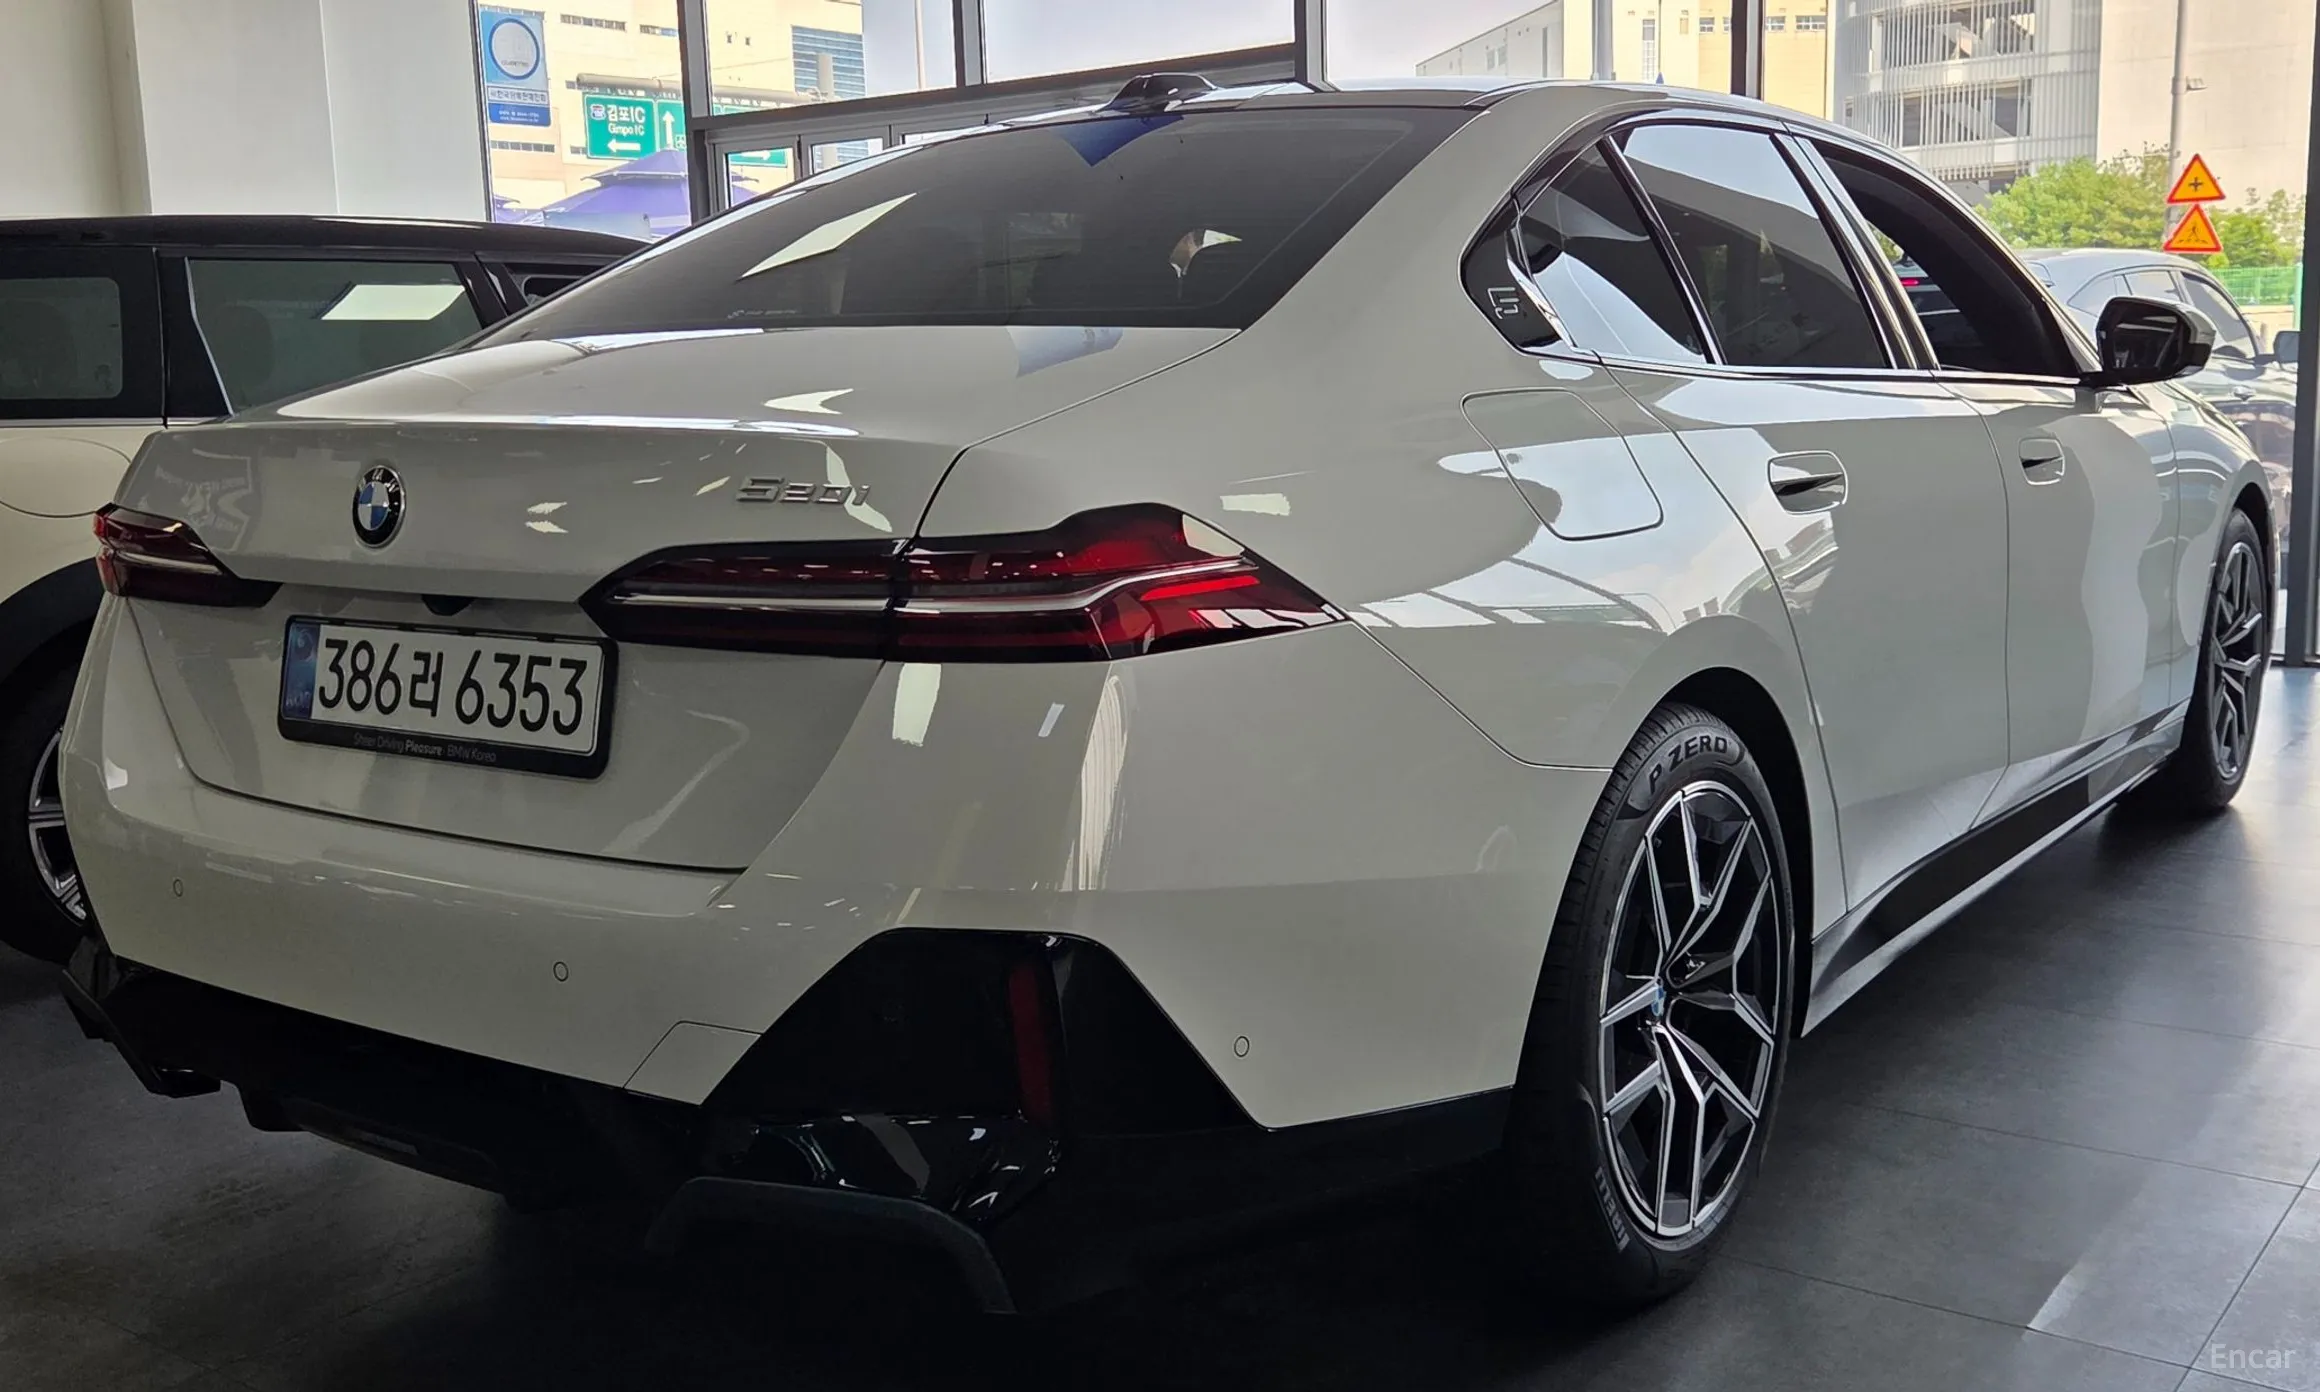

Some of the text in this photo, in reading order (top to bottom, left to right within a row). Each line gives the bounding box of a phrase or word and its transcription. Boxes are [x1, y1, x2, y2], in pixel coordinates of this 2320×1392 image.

[607, 104, 646, 124] 김포IC
[608, 123, 645, 136] Gimpo IC
[735, 476, 871, 506] 520i
[318, 638, 589, 736] 386러 6353
[353, 732, 497, 762] Sheer Driving Pleasure BMW Korea
[1648, 735, 1728, 796] P ZERO
